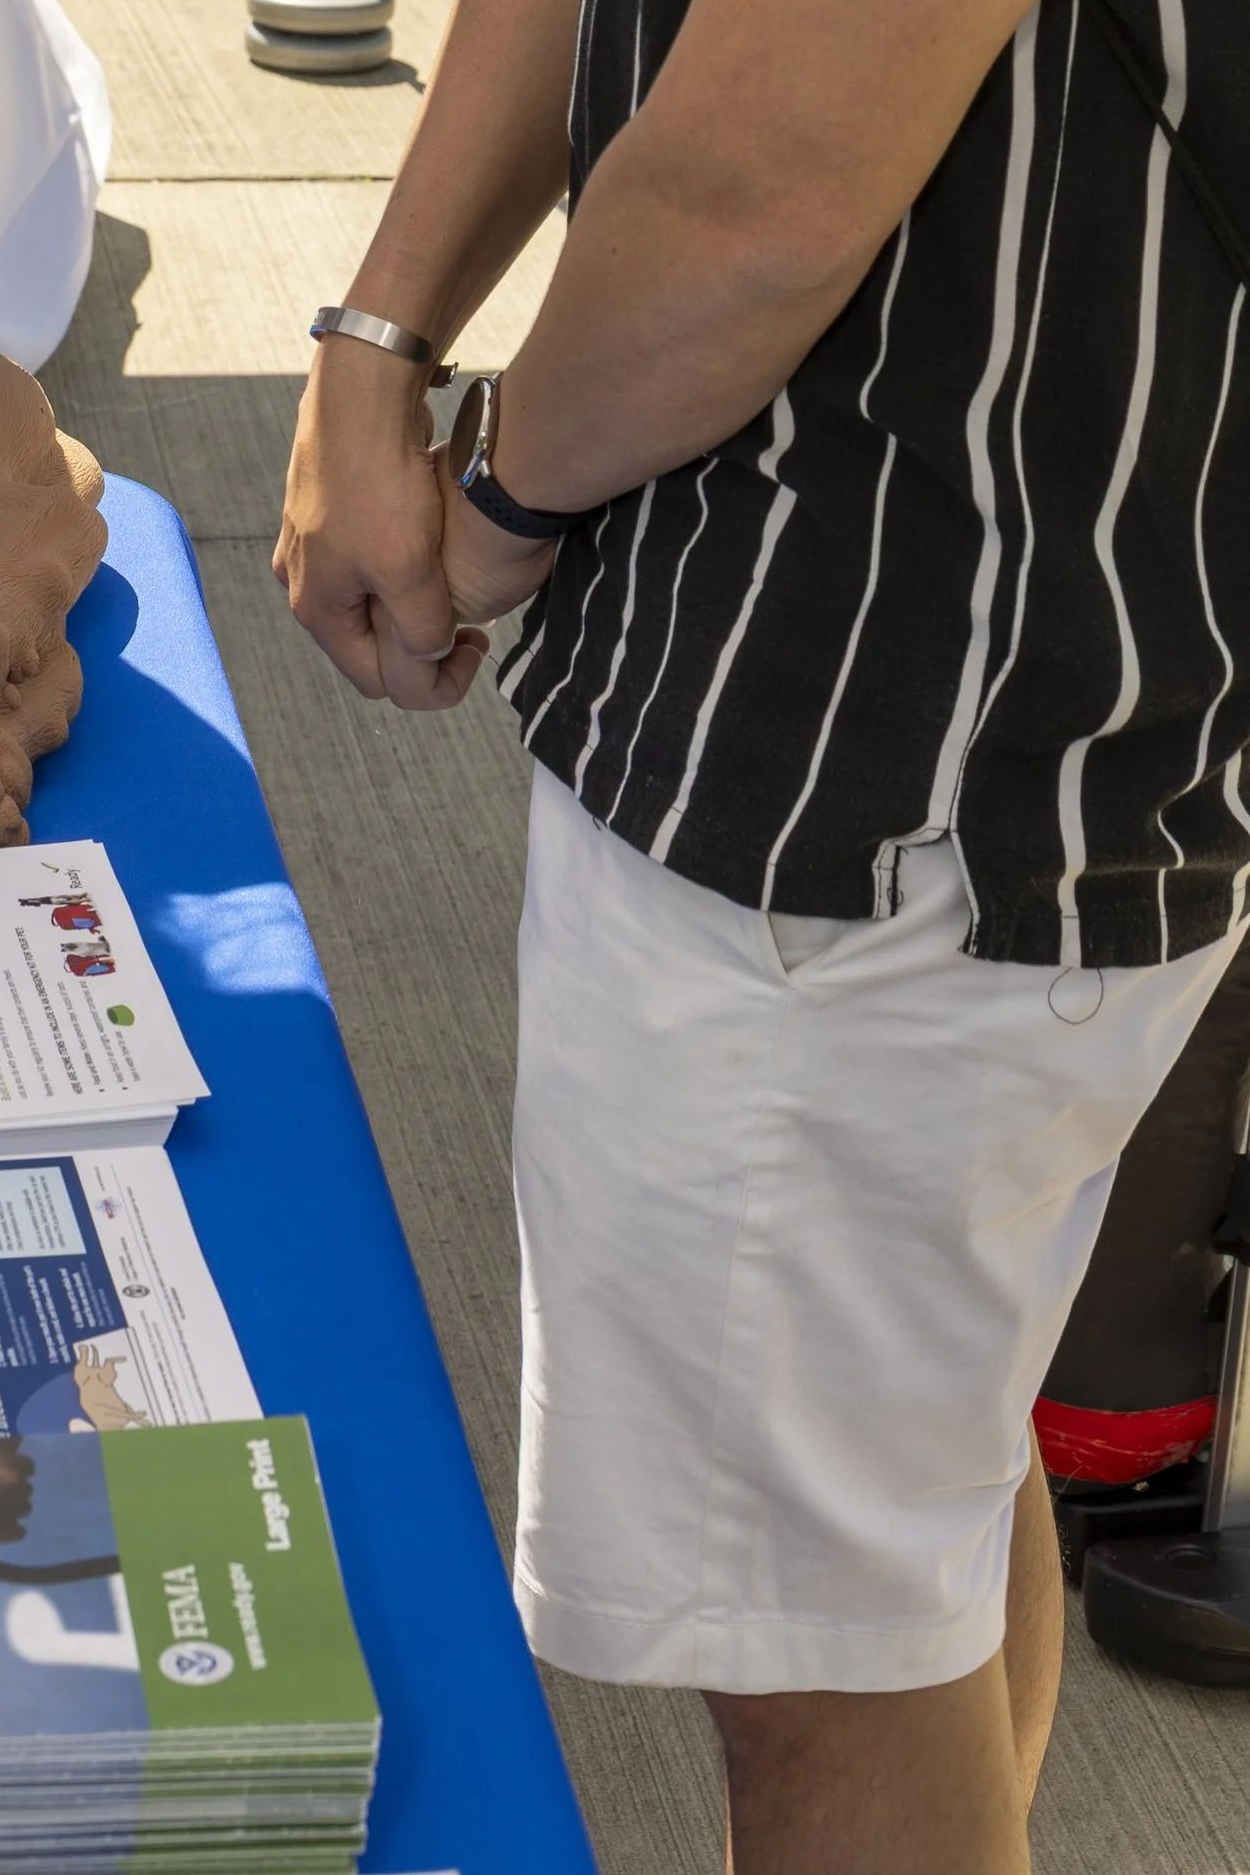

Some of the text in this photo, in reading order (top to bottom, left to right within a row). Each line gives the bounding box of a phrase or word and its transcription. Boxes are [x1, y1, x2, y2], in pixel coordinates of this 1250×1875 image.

[65, 869, 83, 888] Ready
[245, 1439, 291, 1551] Large Print
[161, 1564, 208, 1639] FEMA
